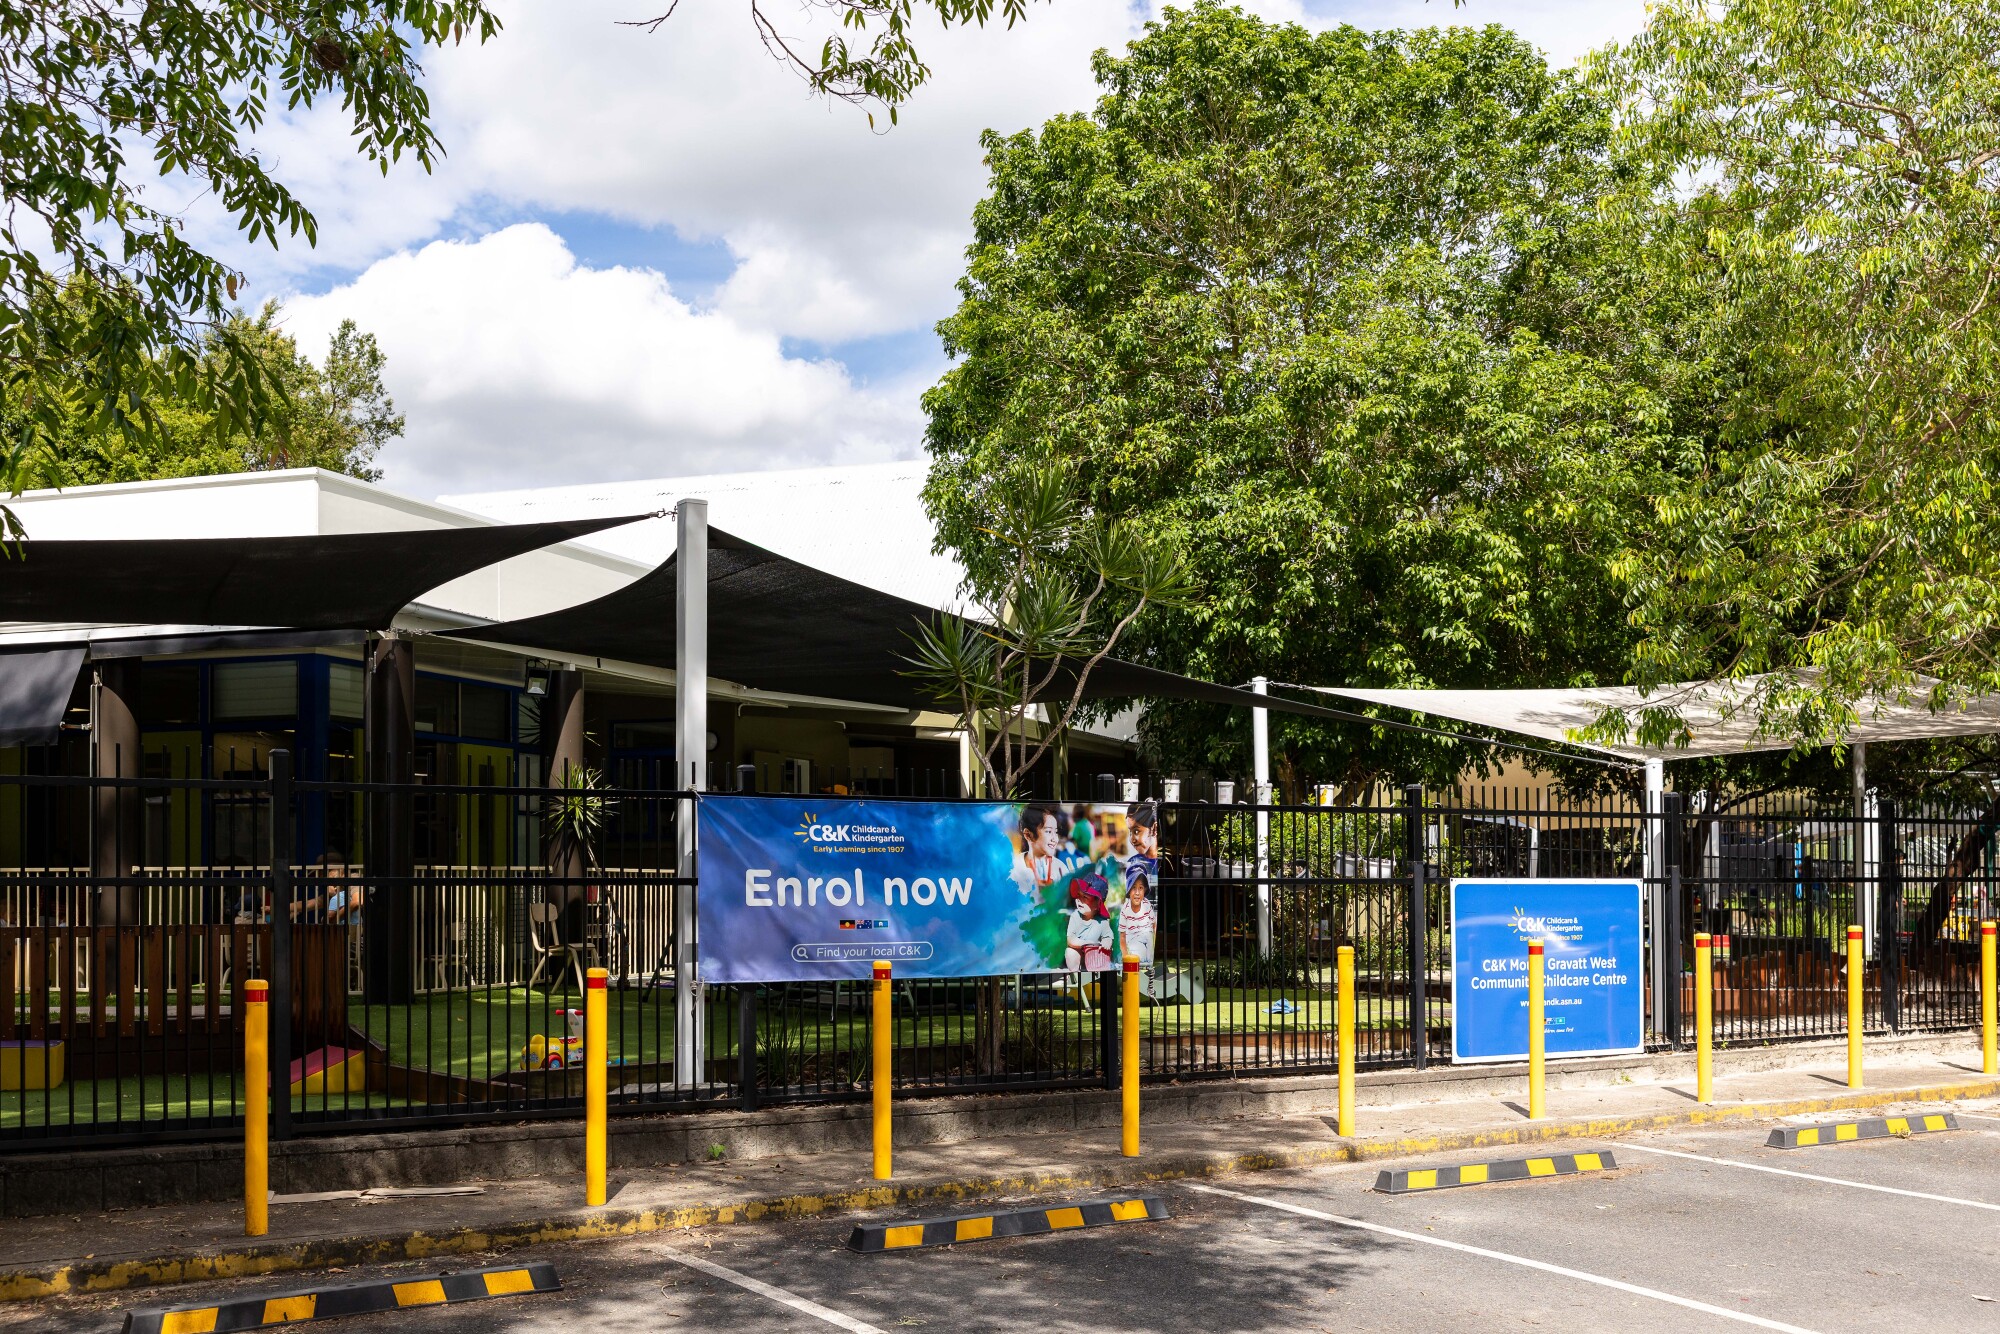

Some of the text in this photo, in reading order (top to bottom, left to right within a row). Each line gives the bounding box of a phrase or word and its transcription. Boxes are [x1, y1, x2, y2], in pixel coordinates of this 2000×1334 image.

[809, 824, 851, 842] C&K
[851, 825, 889, 834] Childcare
[851, 834, 905, 844] Kindergarten
[745, 868, 973, 907] Enrol now
[1517, 916, 1547, 932] C&K
[1546, 925, 1583, 933] Kindergarten
[816, 945, 921, 958] Find your local C&K
[1482, 959, 1507, 972] C&K
[1547, 957, 1588, 970] Gravatt
[1589, 956, 1617, 969] West
[1471, 976, 1530, 990] Communit
[1592, 973, 1627, 986] Centre
